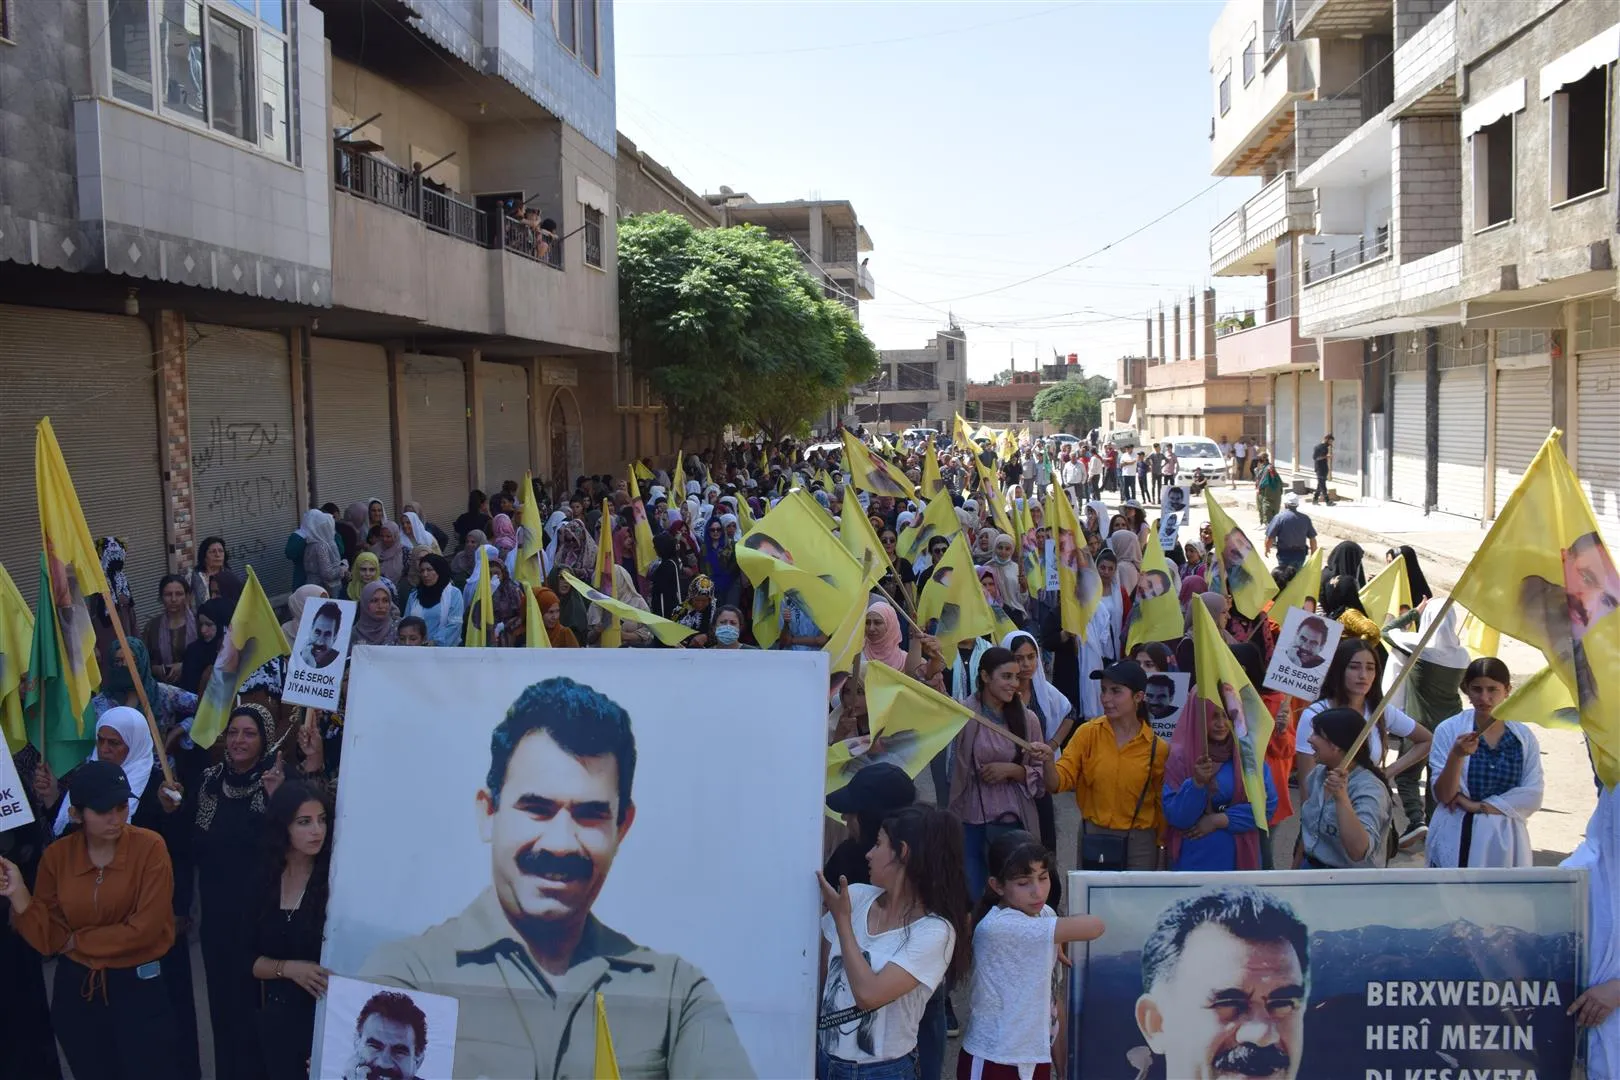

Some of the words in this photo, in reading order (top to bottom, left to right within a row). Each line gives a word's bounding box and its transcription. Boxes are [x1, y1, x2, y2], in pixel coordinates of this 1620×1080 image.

[306, 672, 335, 685] SEROK
[1271, 672, 1295, 686] JIYAN
[1295, 681, 1320, 695] NABE
[1291, 669, 1320, 684] SEROK
[287, 681, 311, 694] JIYAN
[311, 687, 335, 699] NABE
[1151, 722, 1177, 730] EROK
[0, 801, 23, 818] BE
[1367, 980, 1561, 1006] BERXWEDANA
[1366, 1017, 1431, 1050] HERÎ
[1441, 1024, 1534, 1050] MEZIN
